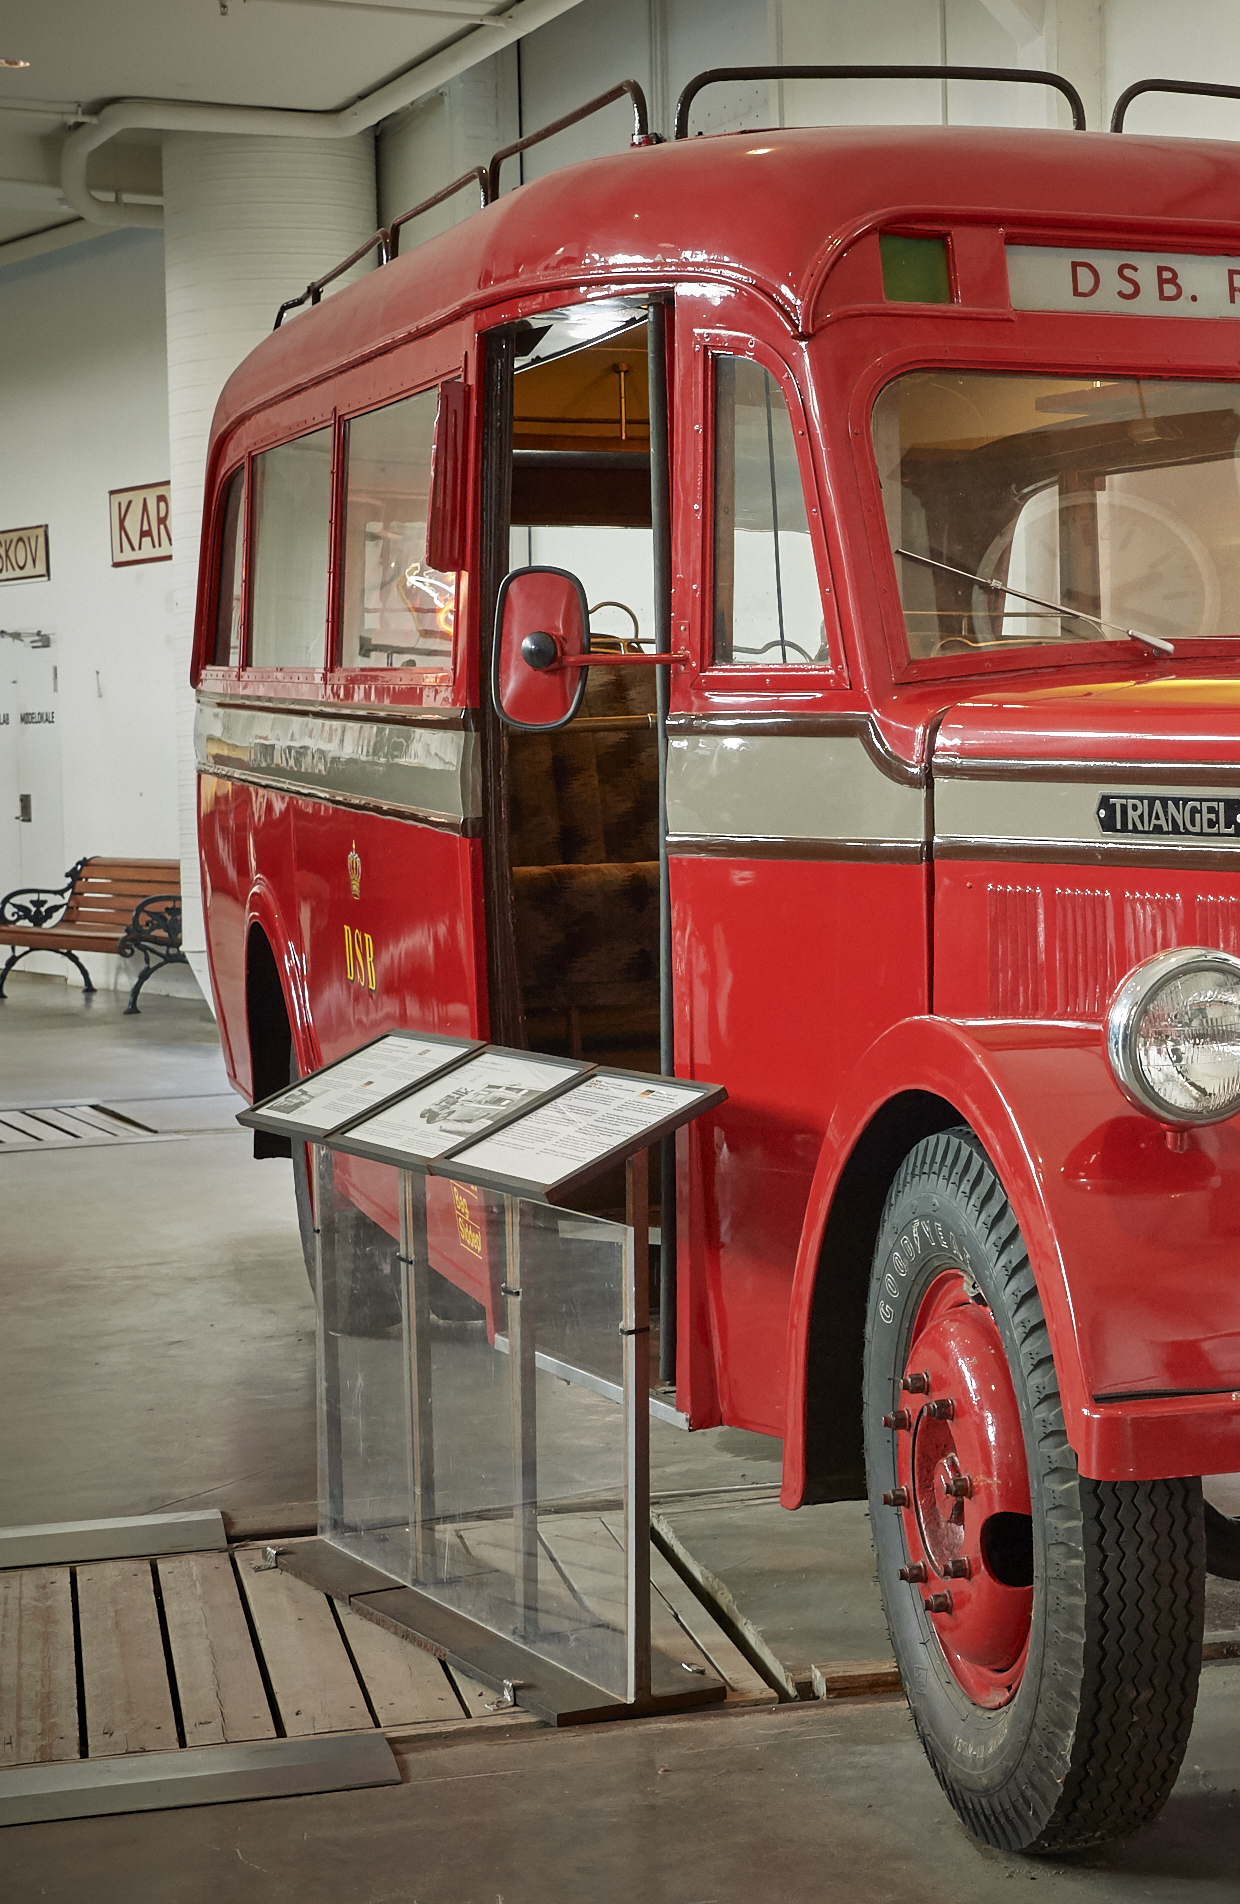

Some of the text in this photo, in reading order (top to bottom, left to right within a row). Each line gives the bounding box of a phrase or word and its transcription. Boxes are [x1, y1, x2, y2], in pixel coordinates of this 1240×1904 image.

[1071, 260, 1198, 303] DSB.
[117, 493, 172, 554] KAR
[1109, 798, 1236, 834] TRIANGEL
[343, 924, 376, 991] DSB
